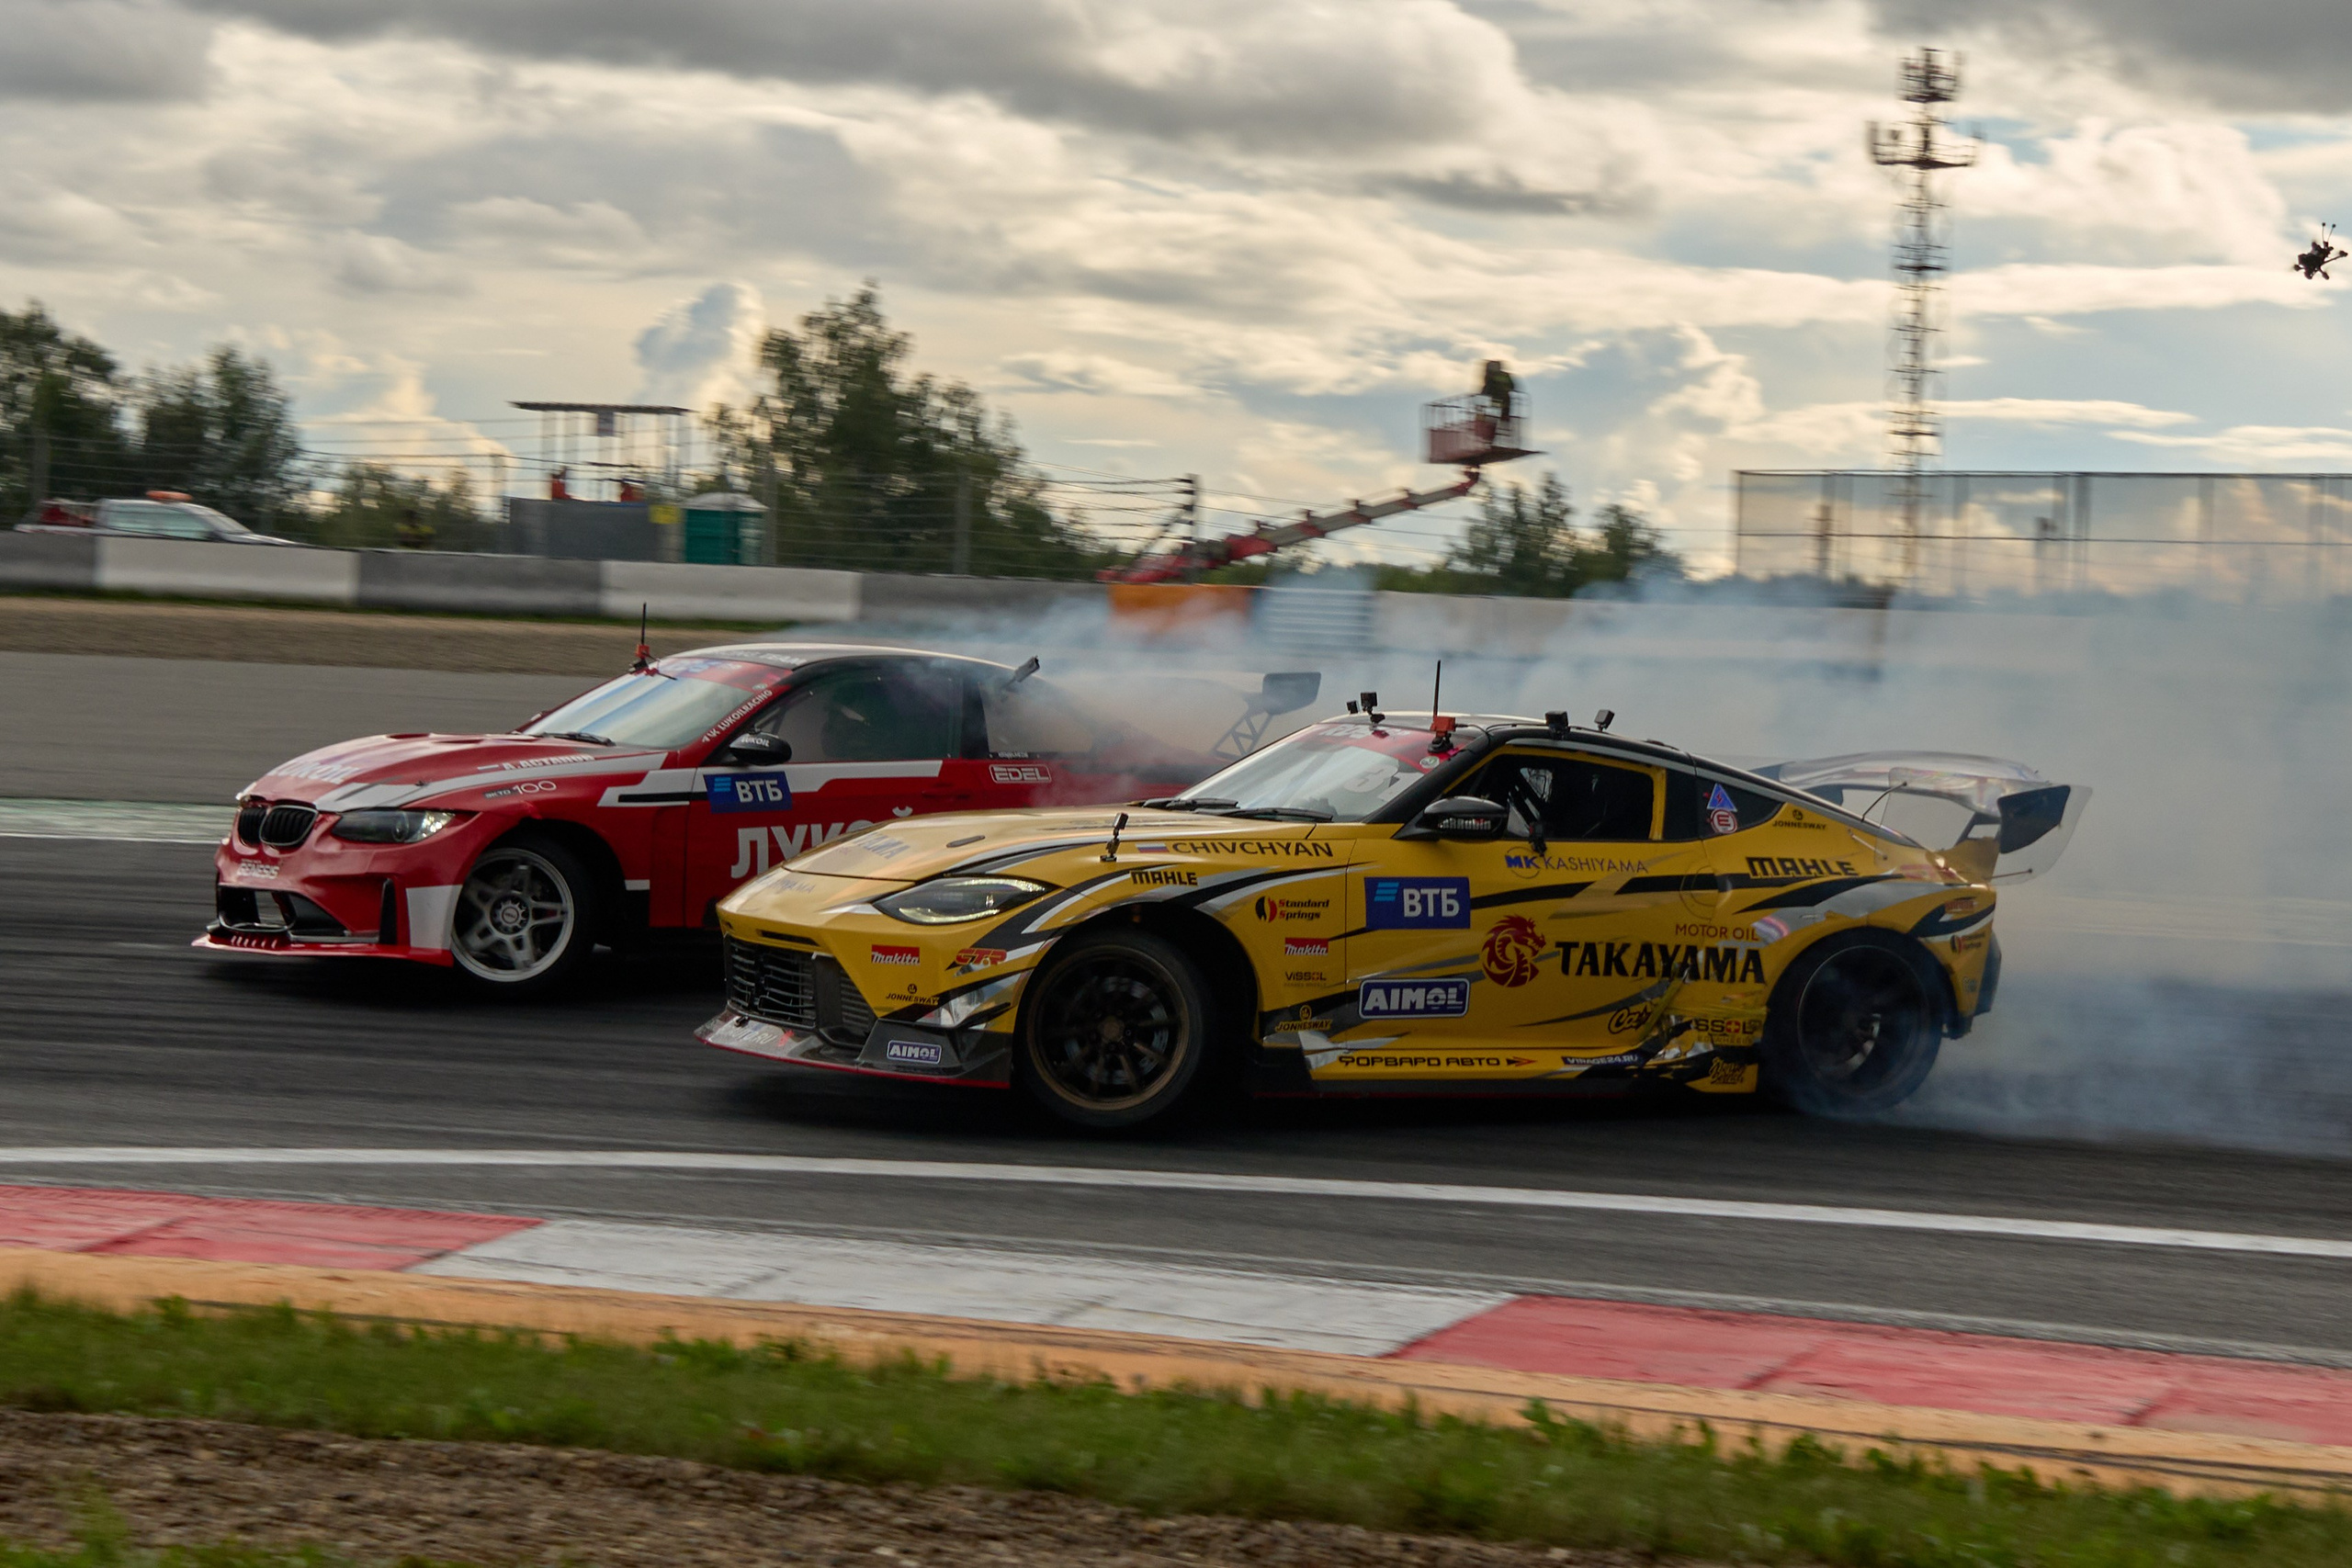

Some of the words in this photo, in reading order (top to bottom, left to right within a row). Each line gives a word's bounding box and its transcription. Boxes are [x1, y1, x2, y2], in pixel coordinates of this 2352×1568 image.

[741, 734, 770, 747] LUKOIL
[993, 765, 1049, 781] EDEL
[513, 780, 557, 795] 100
[735, 778, 784, 805] ВТБ
[1772, 819, 1827, 830] JONNESWAY
[1171, 840, 1334, 858] CHIVCHYAN
[1544, 855, 1648, 874] KASHIYAMA
[1746, 856, 1860, 877] MAHLE
[1131, 870, 1198, 886] MAHLE
[1278, 898, 1330, 908] Standard
[1403, 887, 1460, 918] ВТБ
[1279, 909, 1321, 921] Springs
[1675, 924, 1729, 941] MOTOR
[1733, 926, 1759, 942] OIL
[1285, 942, 1329, 956] makita
[872, 950, 920, 965] makita
[1555, 941, 1766, 984] TAKAYAMA
[885, 992, 939, 1006] JONNESWAY
[1364, 986, 1464, 1012] AIMOL
[1275, 1021, 1331, 1032] JONNESWAY
[888, 1043, 938, 1059] AIMOL
